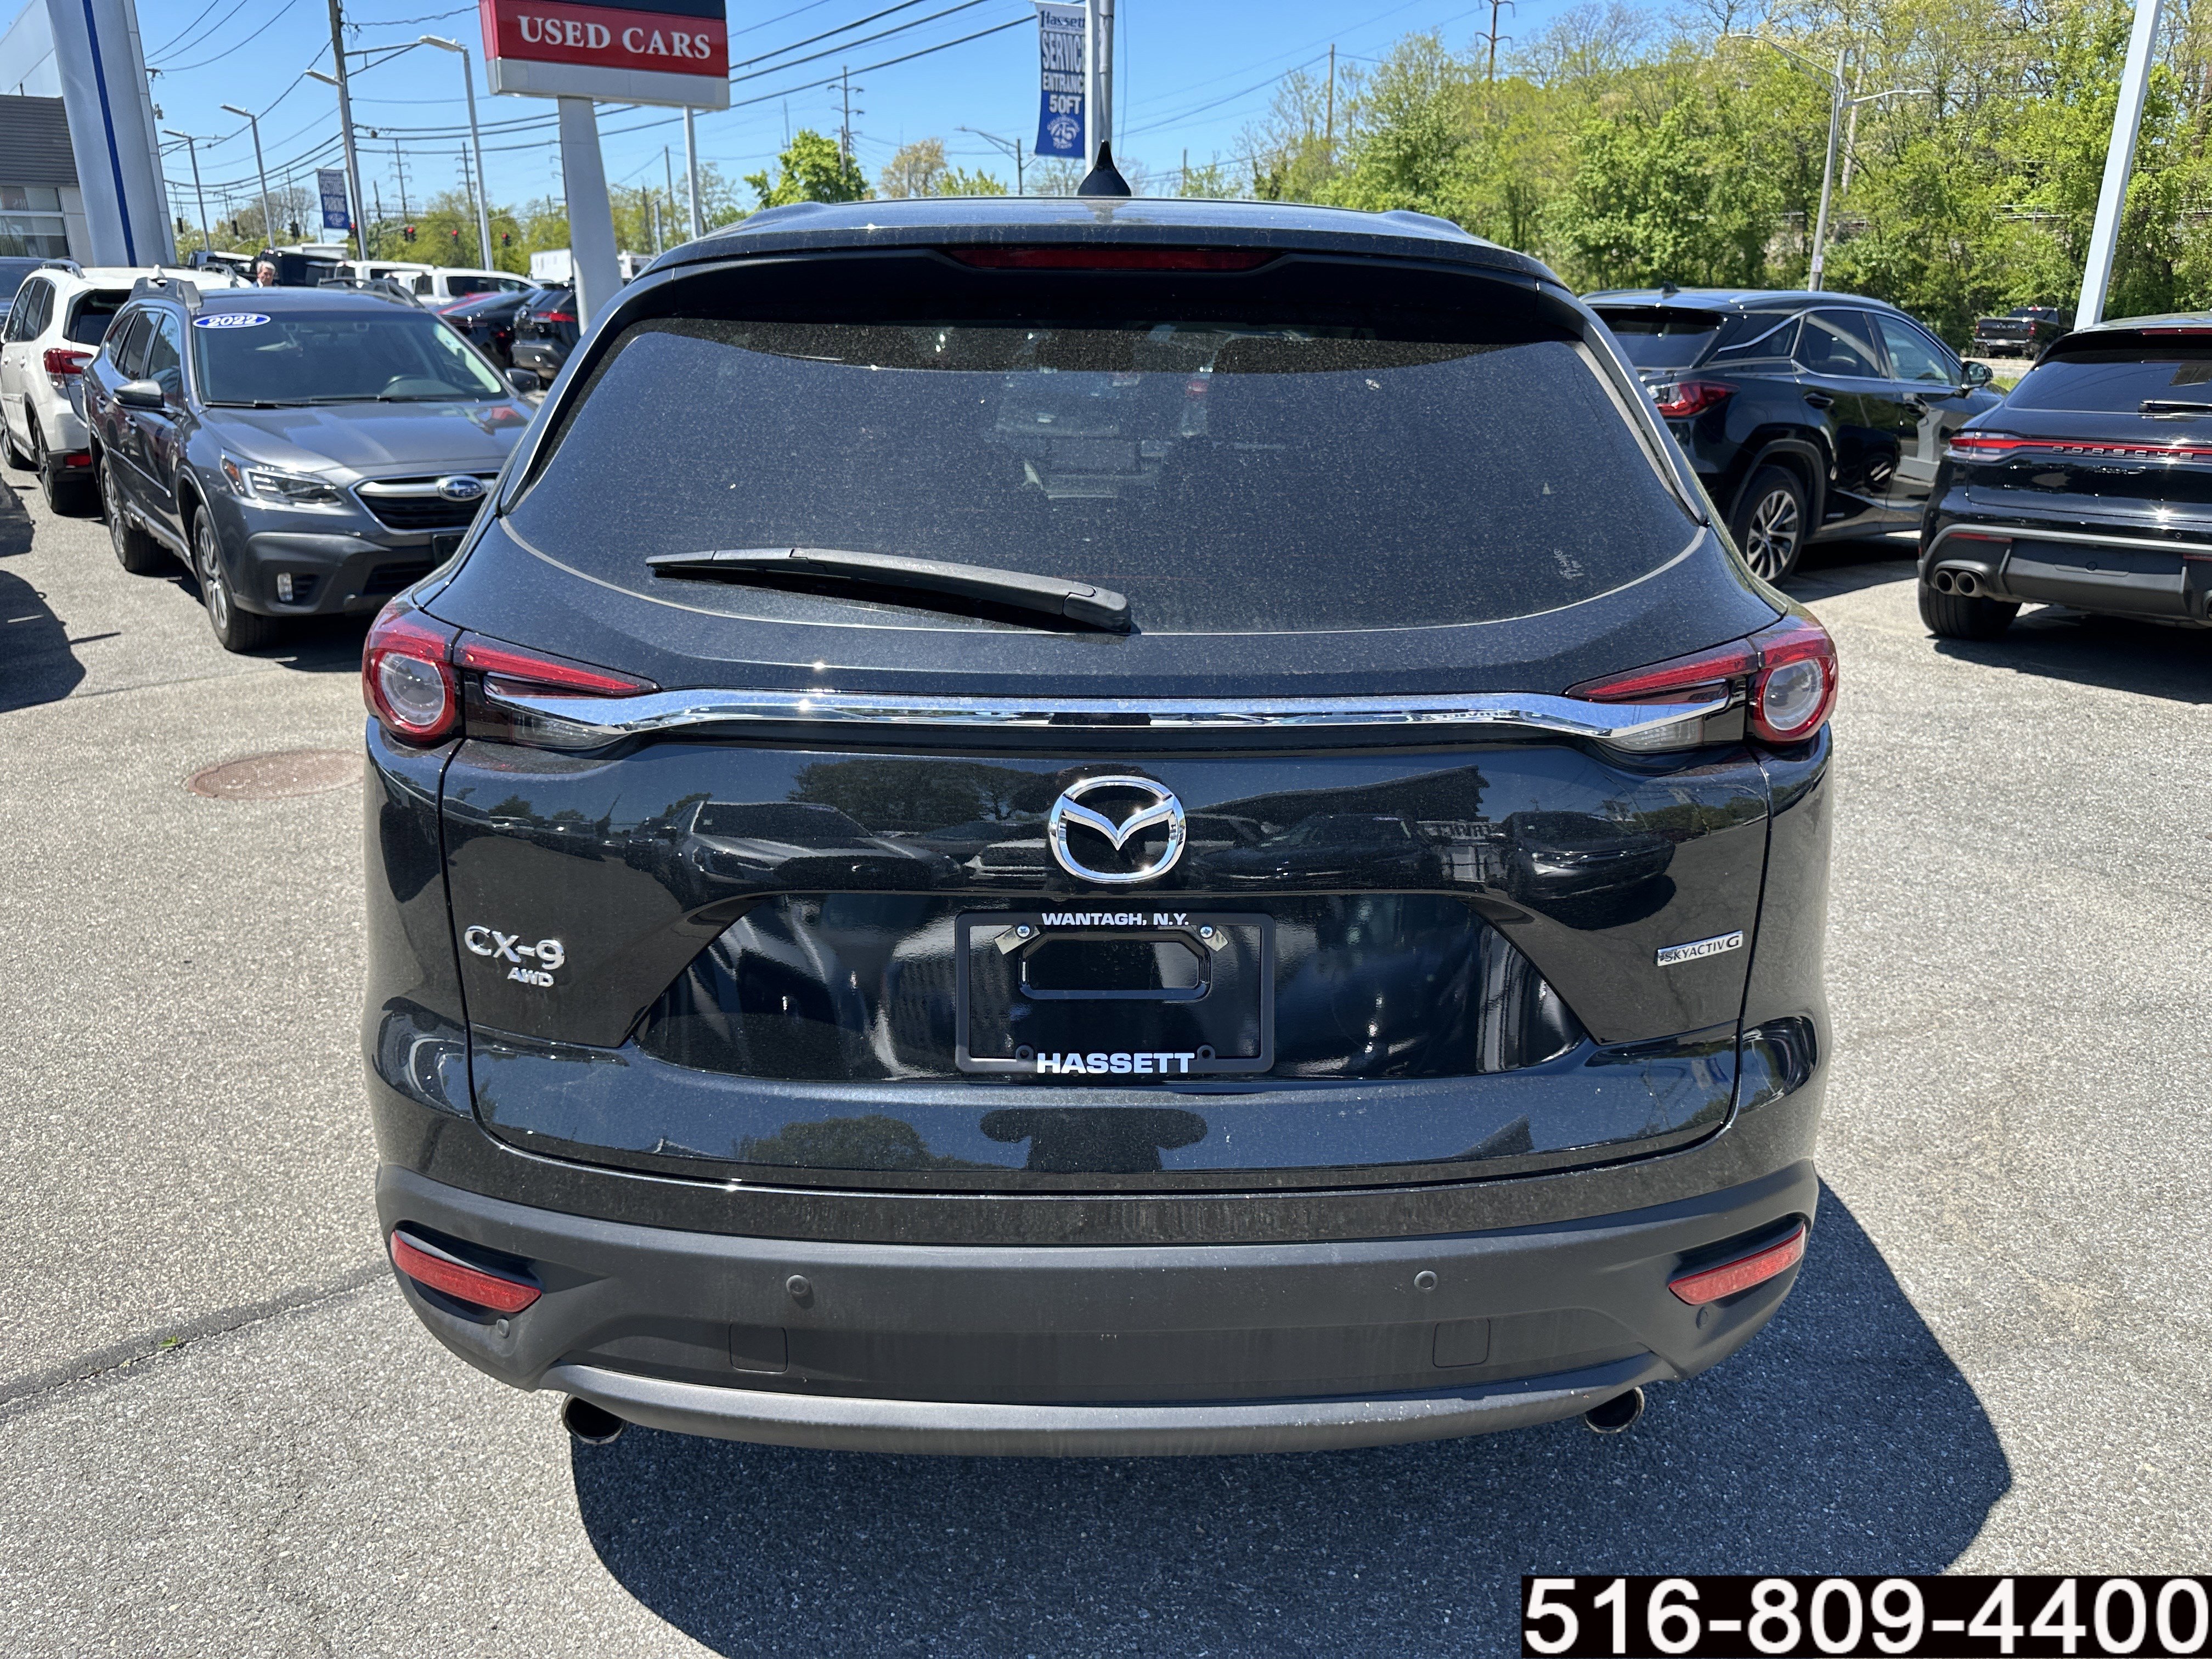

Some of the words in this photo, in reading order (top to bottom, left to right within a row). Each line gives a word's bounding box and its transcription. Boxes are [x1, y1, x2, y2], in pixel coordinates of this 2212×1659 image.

[517, 15, 611, 49] USED
[622, 27, 712, 60] CARS
[1042, 71, 1085, 94] ENTRANC
[1048, 94, 1082, 115] 50FT
[206, 314, 258, 327] 2022
[2052, 445, 2194, 460] PORSCHE
[1041, 912, 1147, 926] WANTAGH,
[1153, 912, 1189, 926] N.Y.
[464, 925, 565, 970] CX-9
[507, 967, 554, 988] AWD
[1037, 1052, 1195, 1074] HASSETT
